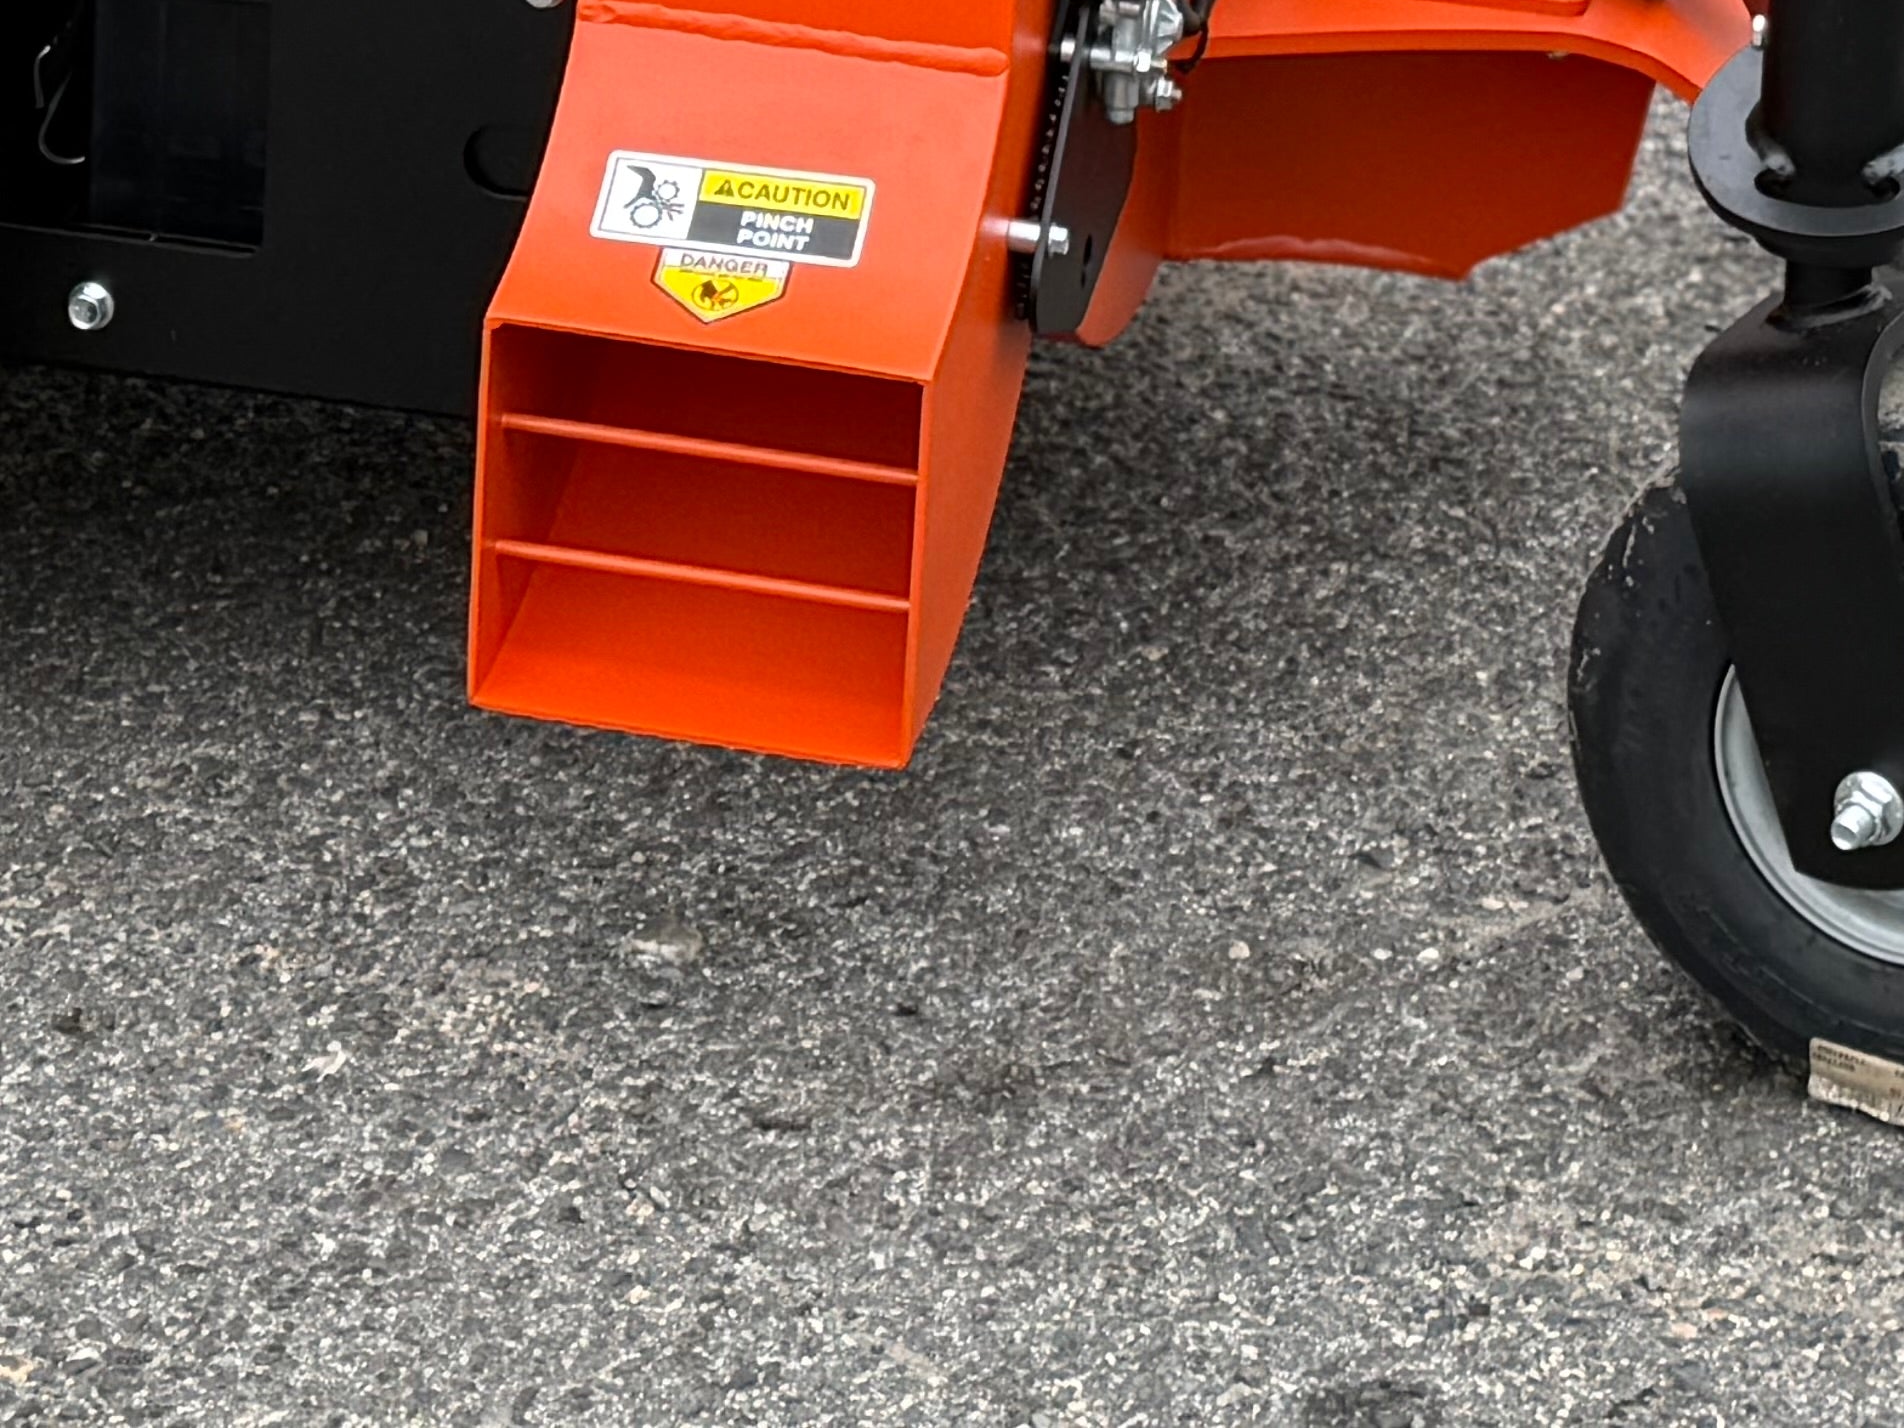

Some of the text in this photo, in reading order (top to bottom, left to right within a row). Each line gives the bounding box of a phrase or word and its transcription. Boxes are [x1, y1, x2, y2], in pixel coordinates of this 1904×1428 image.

[737, 181, 850, 211] CAUTION
[740, 210, 815, 234] PINCH
[736, 229, 811, 251] POINT
[680, 253, 769, 278] DANGER
